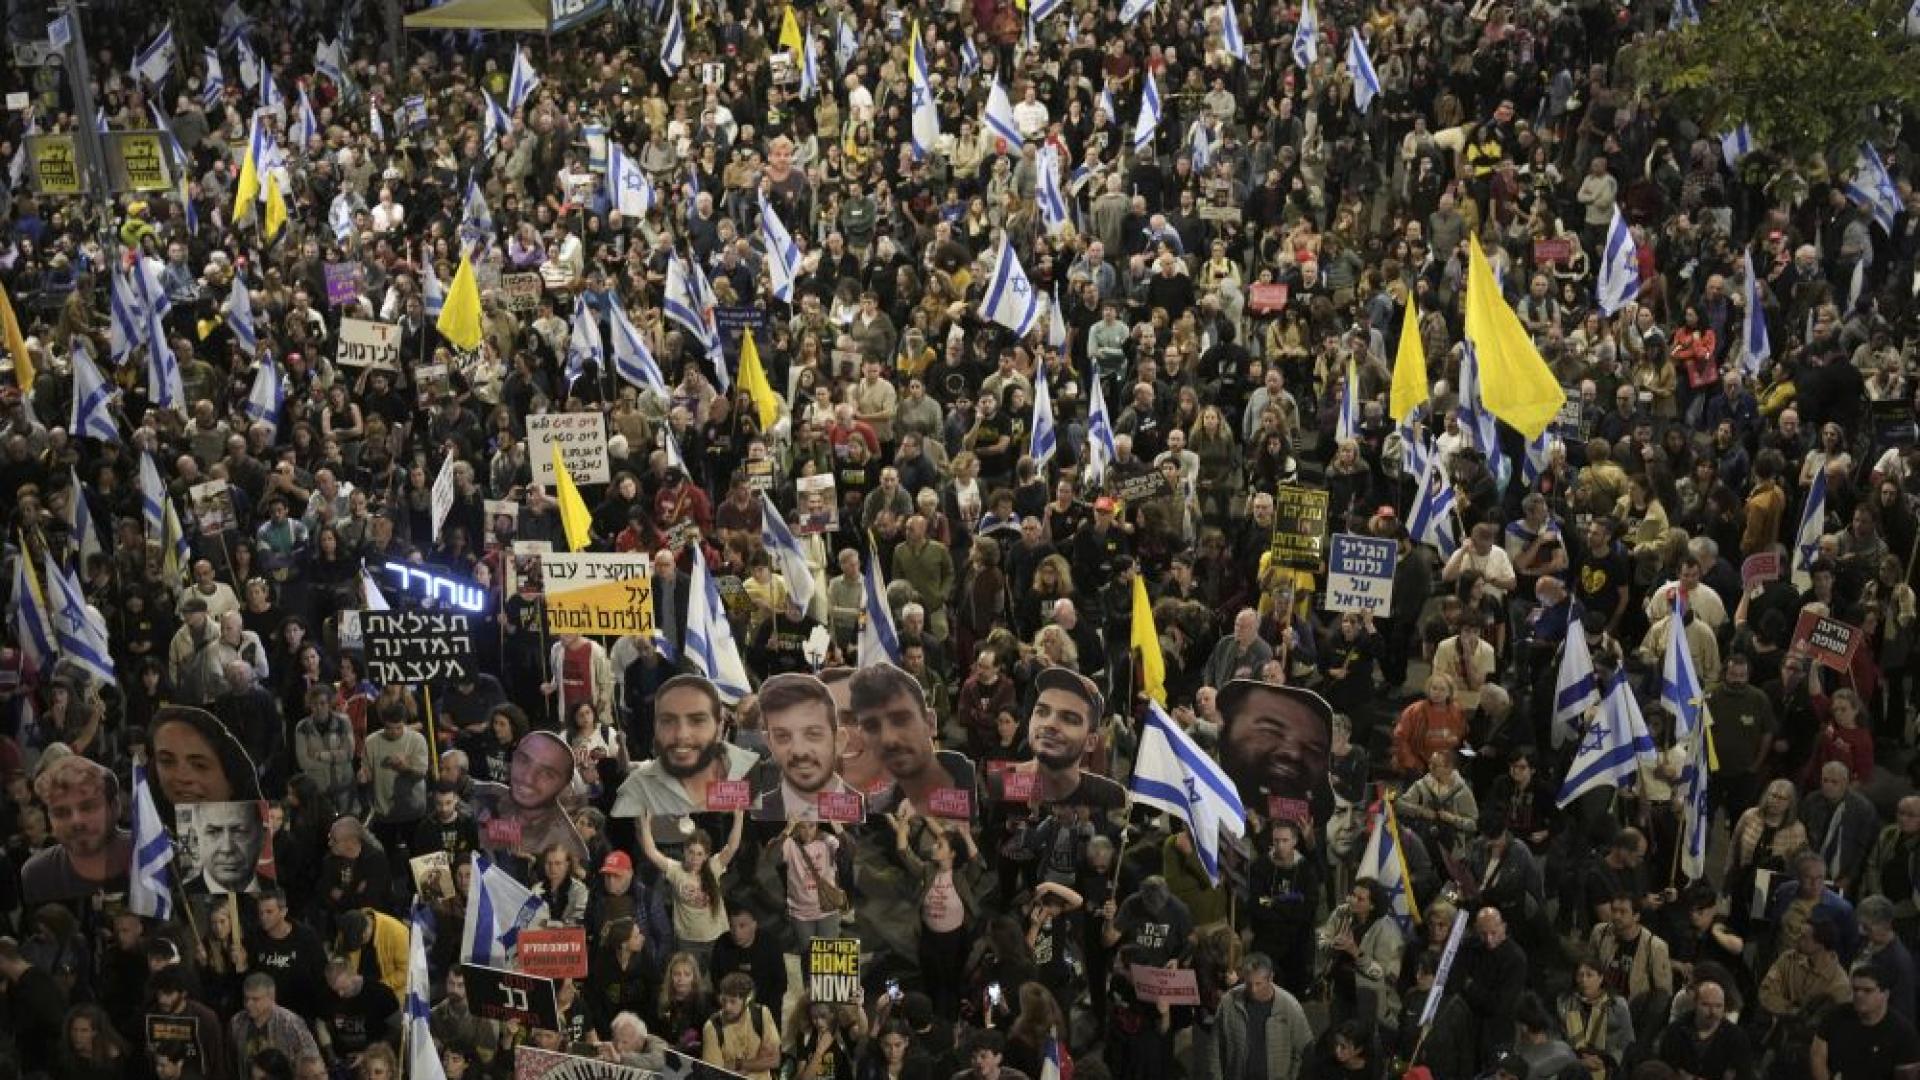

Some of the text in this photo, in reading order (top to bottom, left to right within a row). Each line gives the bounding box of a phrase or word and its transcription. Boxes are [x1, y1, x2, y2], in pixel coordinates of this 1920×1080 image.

[1341, 539, 1389, 560] הגליל
[1343, 556, 1383, 574] נלחם
[385, 561, 484, 612] שחרר
[624, 584, 650, 604] על
[1350, 577, 1370, 591] על
[1334, 591, 1384, 609] ישראל
[372, 636, 471, 657] המדינה
[367, 659, 466, 687] מעצמך
[811, 940, 828, 952] ALL
[811, 952, 858, 976] HOME
[498, 981, 529, 1011] כל
[811, 974, 858, 1002] NOW!
